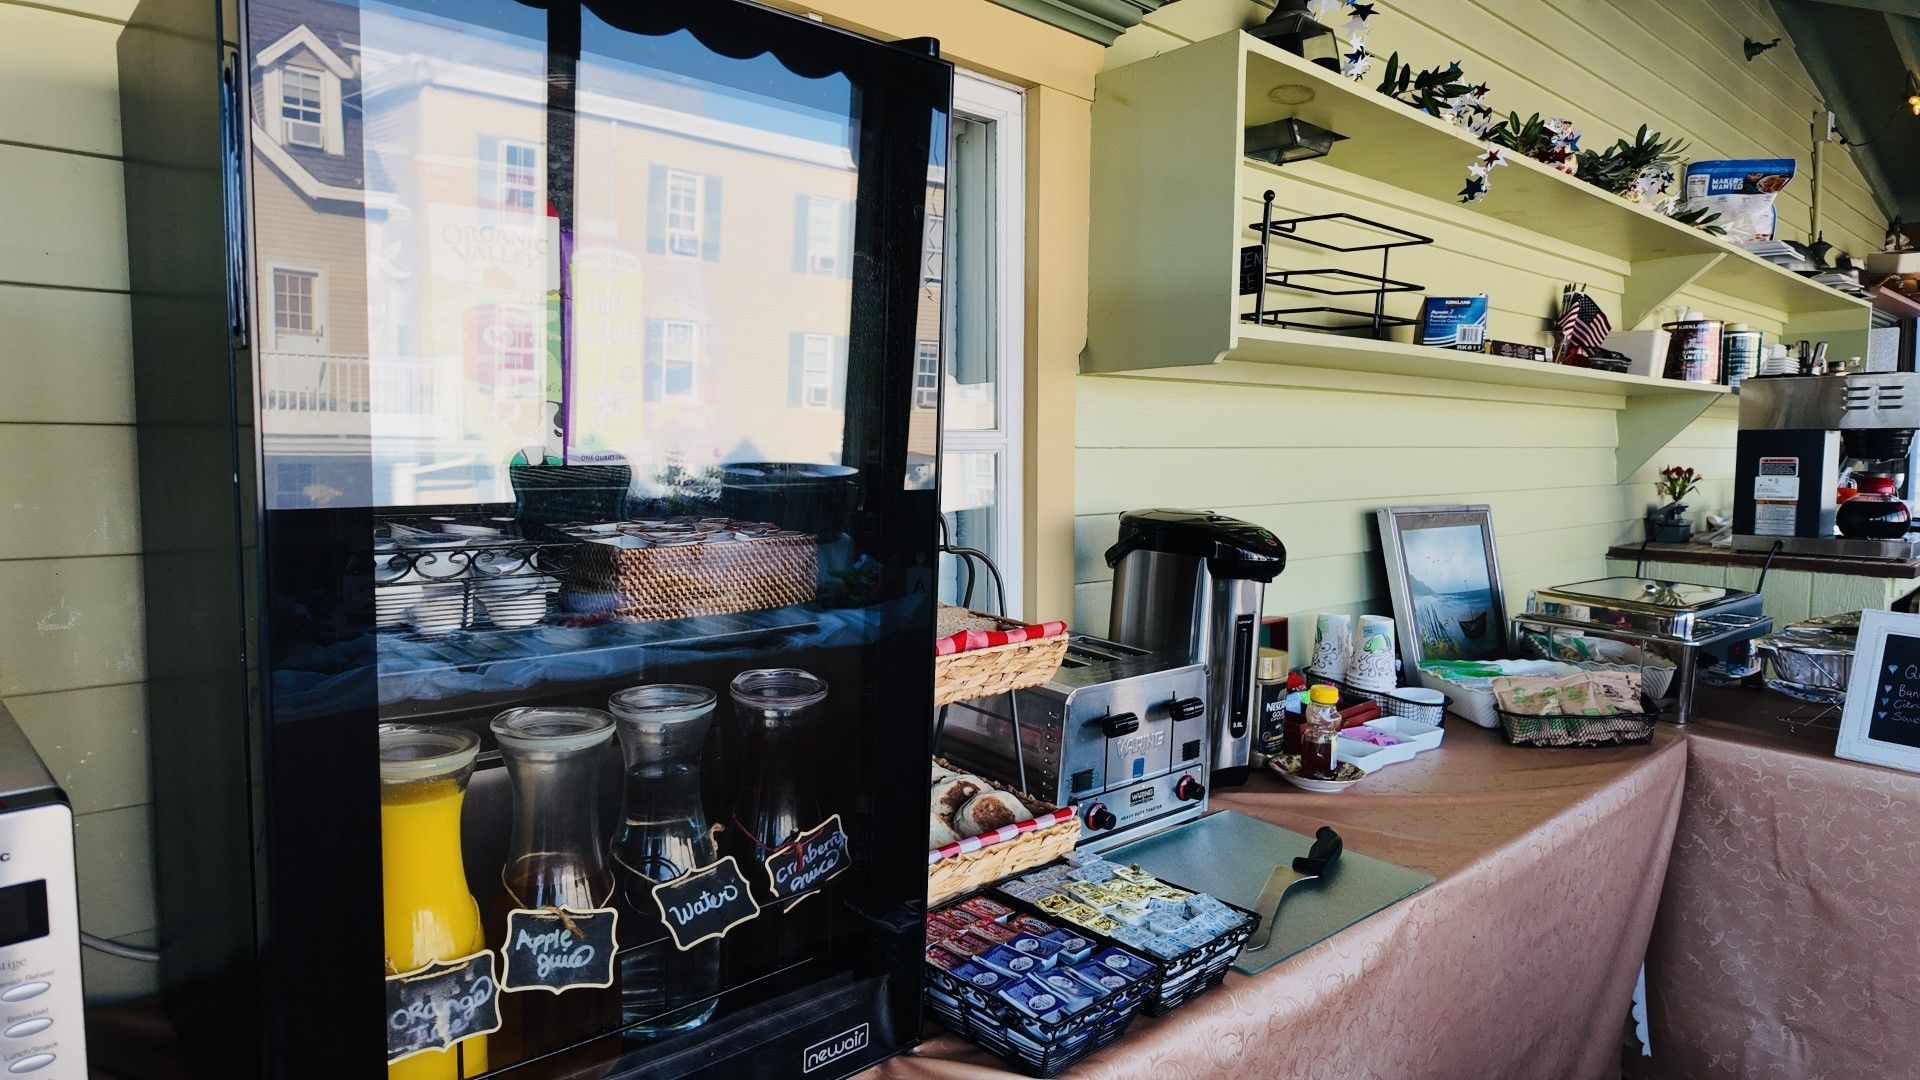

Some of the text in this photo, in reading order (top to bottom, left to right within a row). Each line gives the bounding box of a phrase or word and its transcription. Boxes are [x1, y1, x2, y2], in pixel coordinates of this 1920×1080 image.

[1116, 730, 1165, 758] WARING
[1131, 788, 1154, 801] WARING
[668, 884, 738, 925] Water
[516, 929, 573, 955] Apple
[808, 1030, 865, 1067] newair
